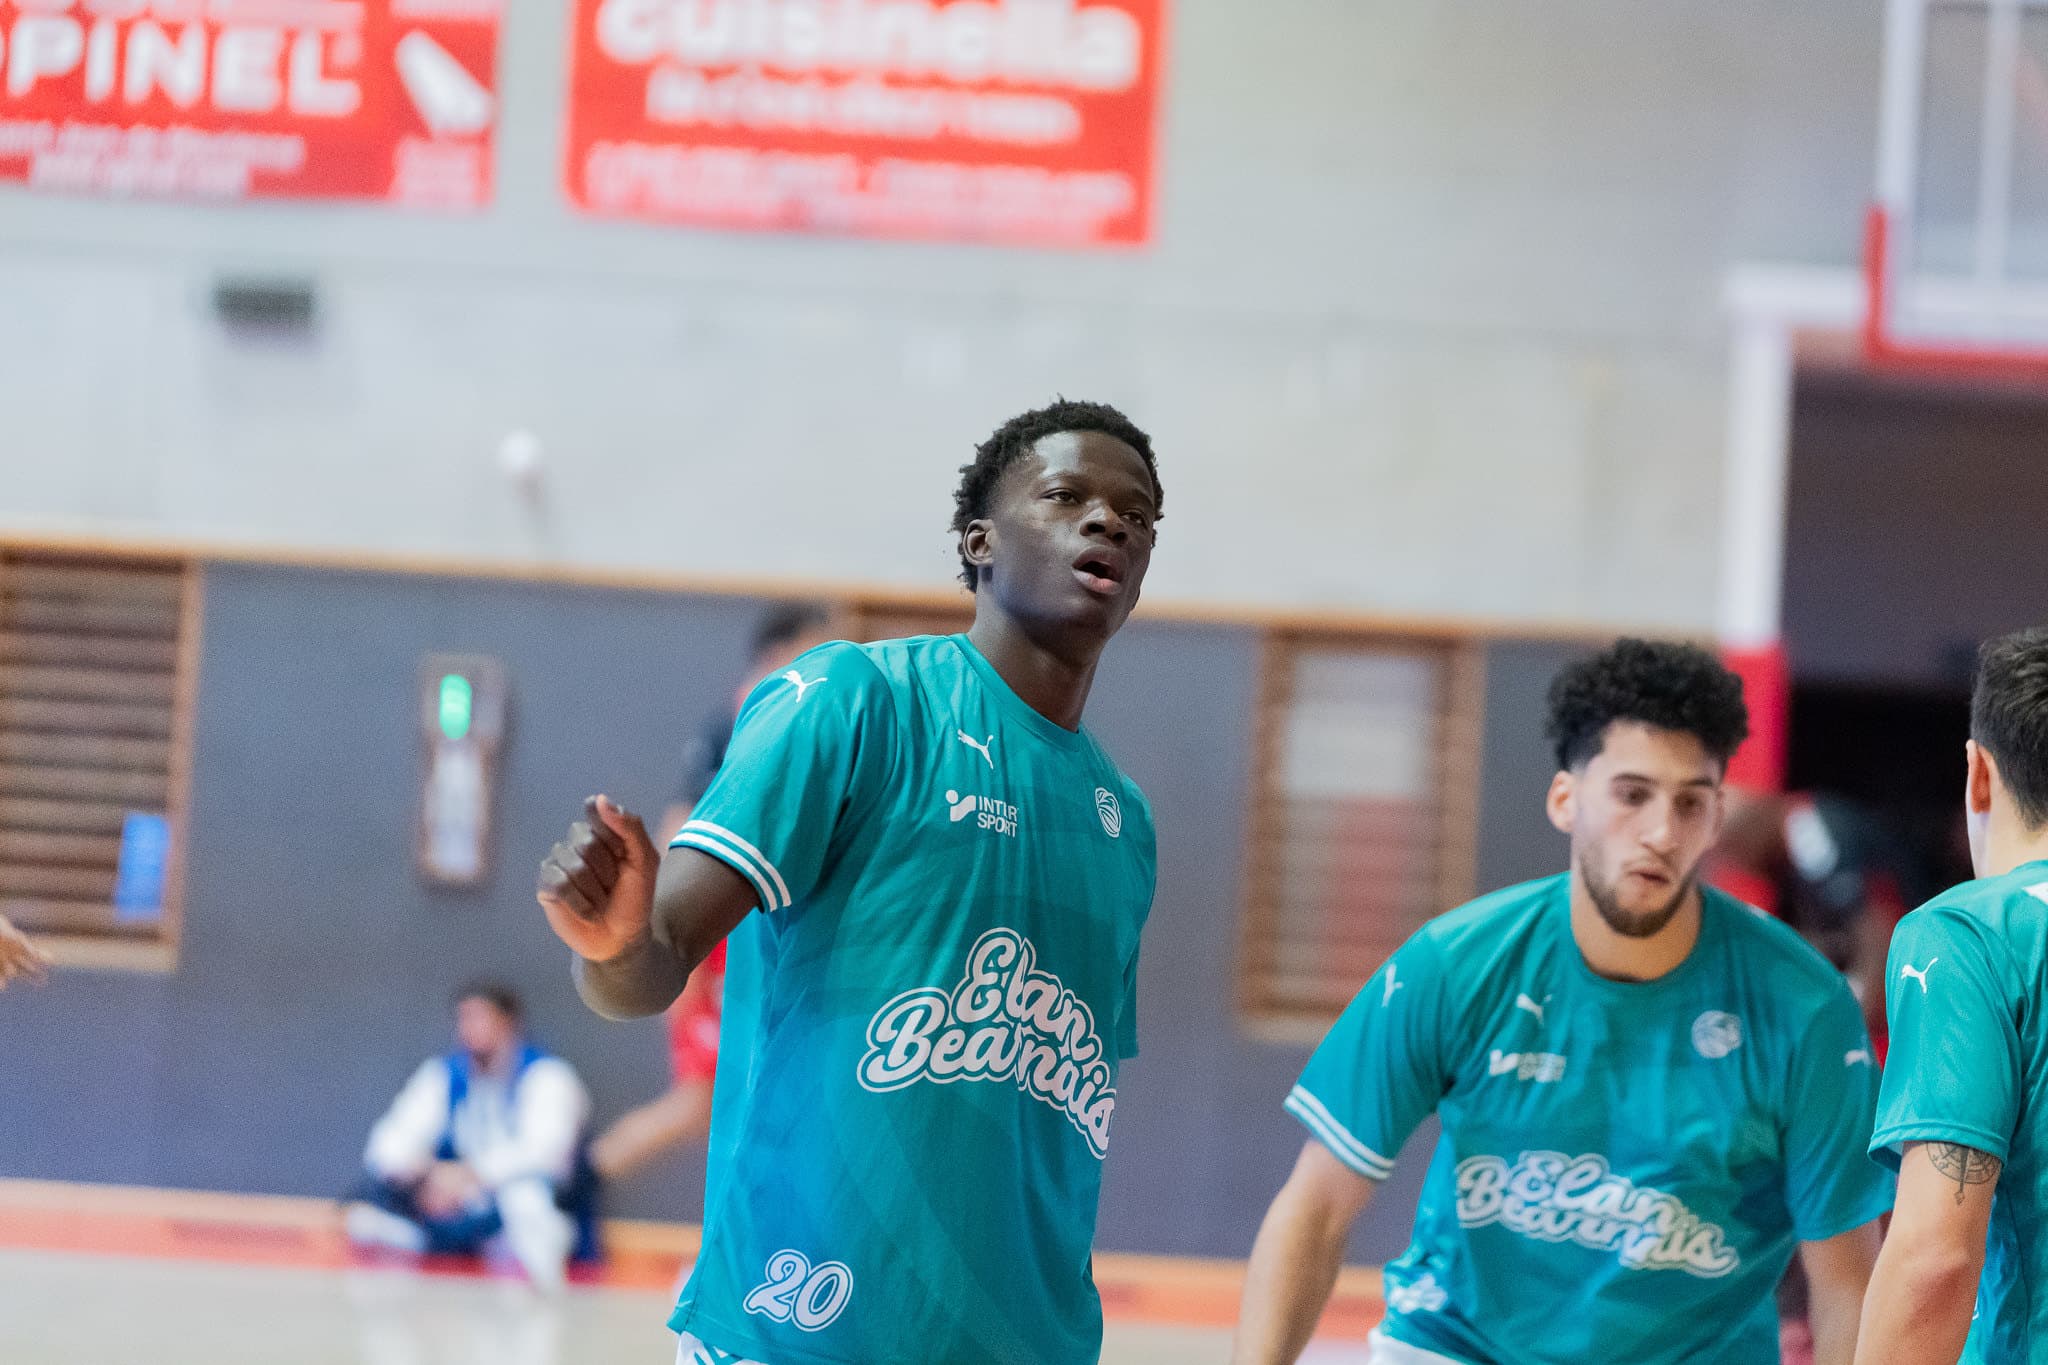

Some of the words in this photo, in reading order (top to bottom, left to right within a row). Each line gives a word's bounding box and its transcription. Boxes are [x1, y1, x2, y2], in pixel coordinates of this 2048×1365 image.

[0, 15, 362, 117] PINEL
[977, 812, 1018, 838] SPORT
[952, 928, 1101, 1064] Elan
[858, 989, 1117, 1158] Beanais
[744, 1250, 852, 1331] 20
